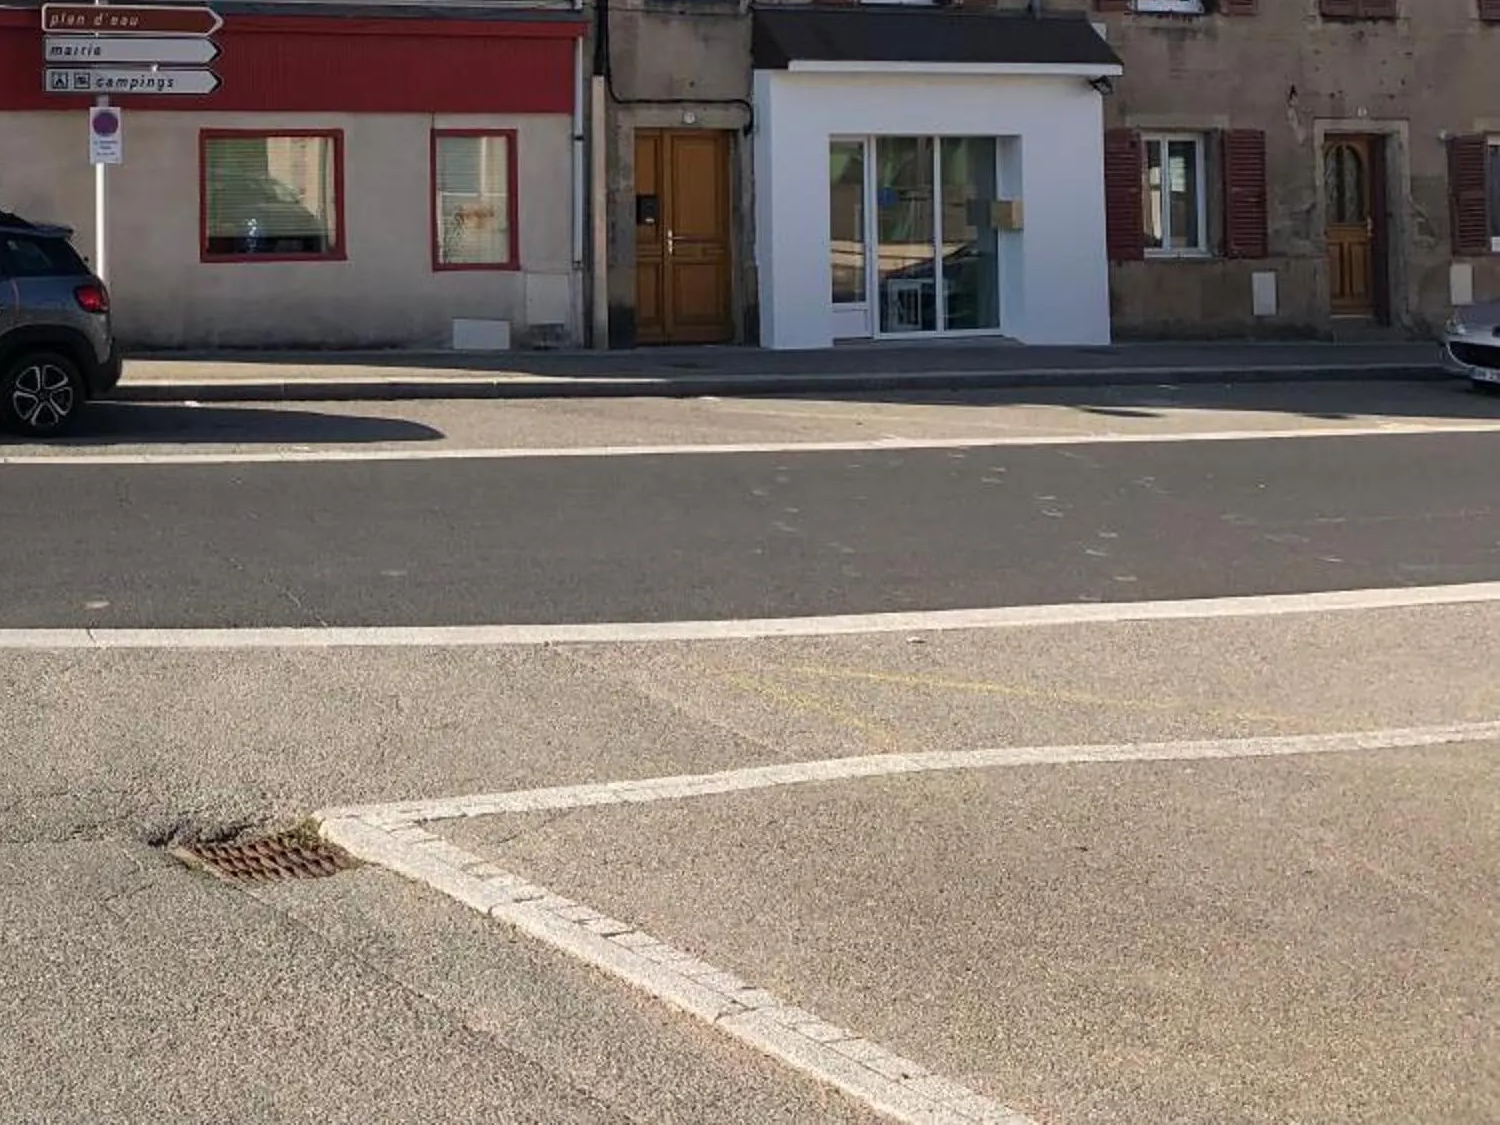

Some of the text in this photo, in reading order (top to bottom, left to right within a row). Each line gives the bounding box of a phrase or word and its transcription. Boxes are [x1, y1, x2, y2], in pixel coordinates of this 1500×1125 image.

[50, 11, 139, 26] plan d'eau
[50, 44, 101, 56] mairie
[96, 74, 174, 91] campings
